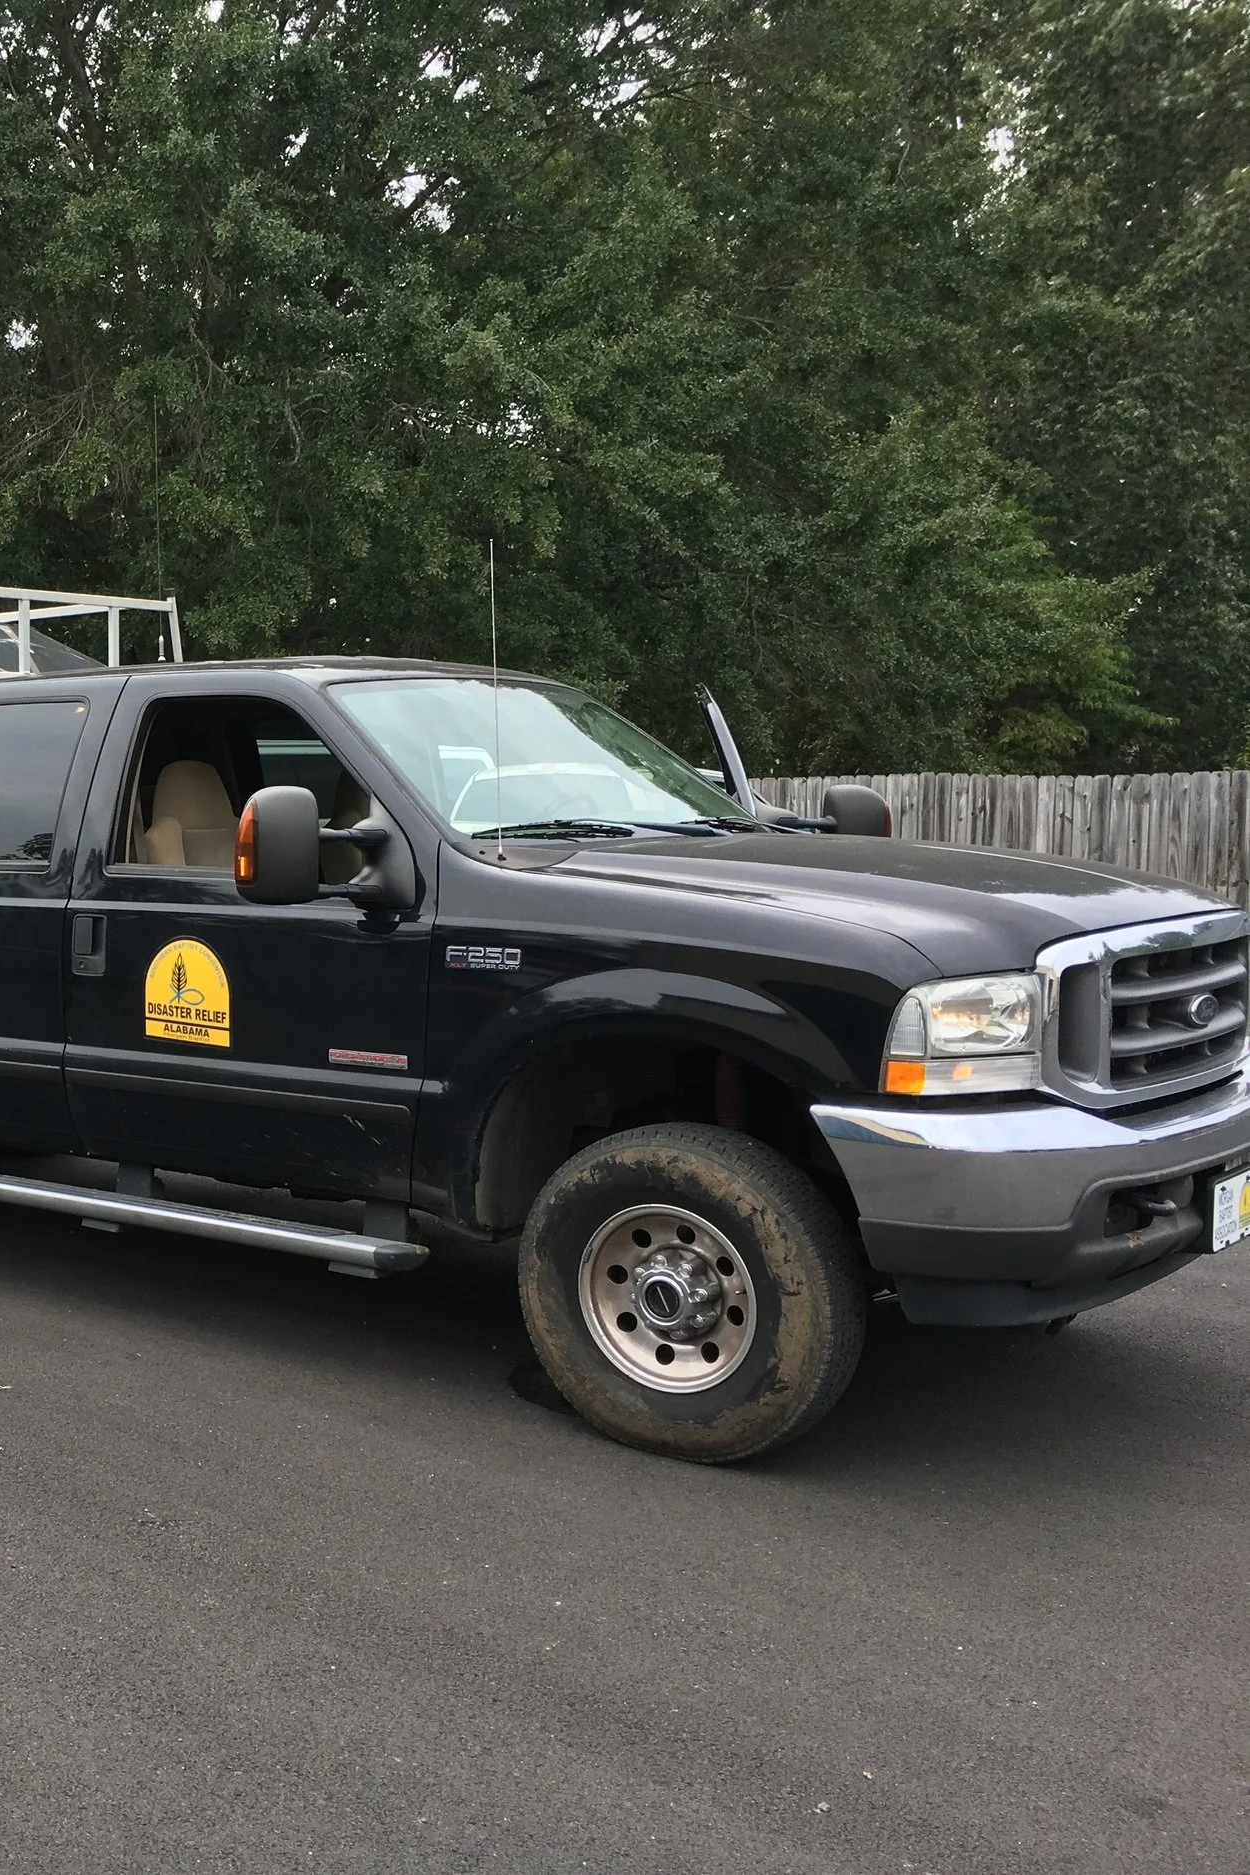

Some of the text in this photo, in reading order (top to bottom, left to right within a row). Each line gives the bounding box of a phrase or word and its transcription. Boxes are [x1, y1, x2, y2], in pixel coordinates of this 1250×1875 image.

[147, 1002, 227, 1024] DISASTER RELIEF
[163, 1023, 210, 1038] ALABAMA
